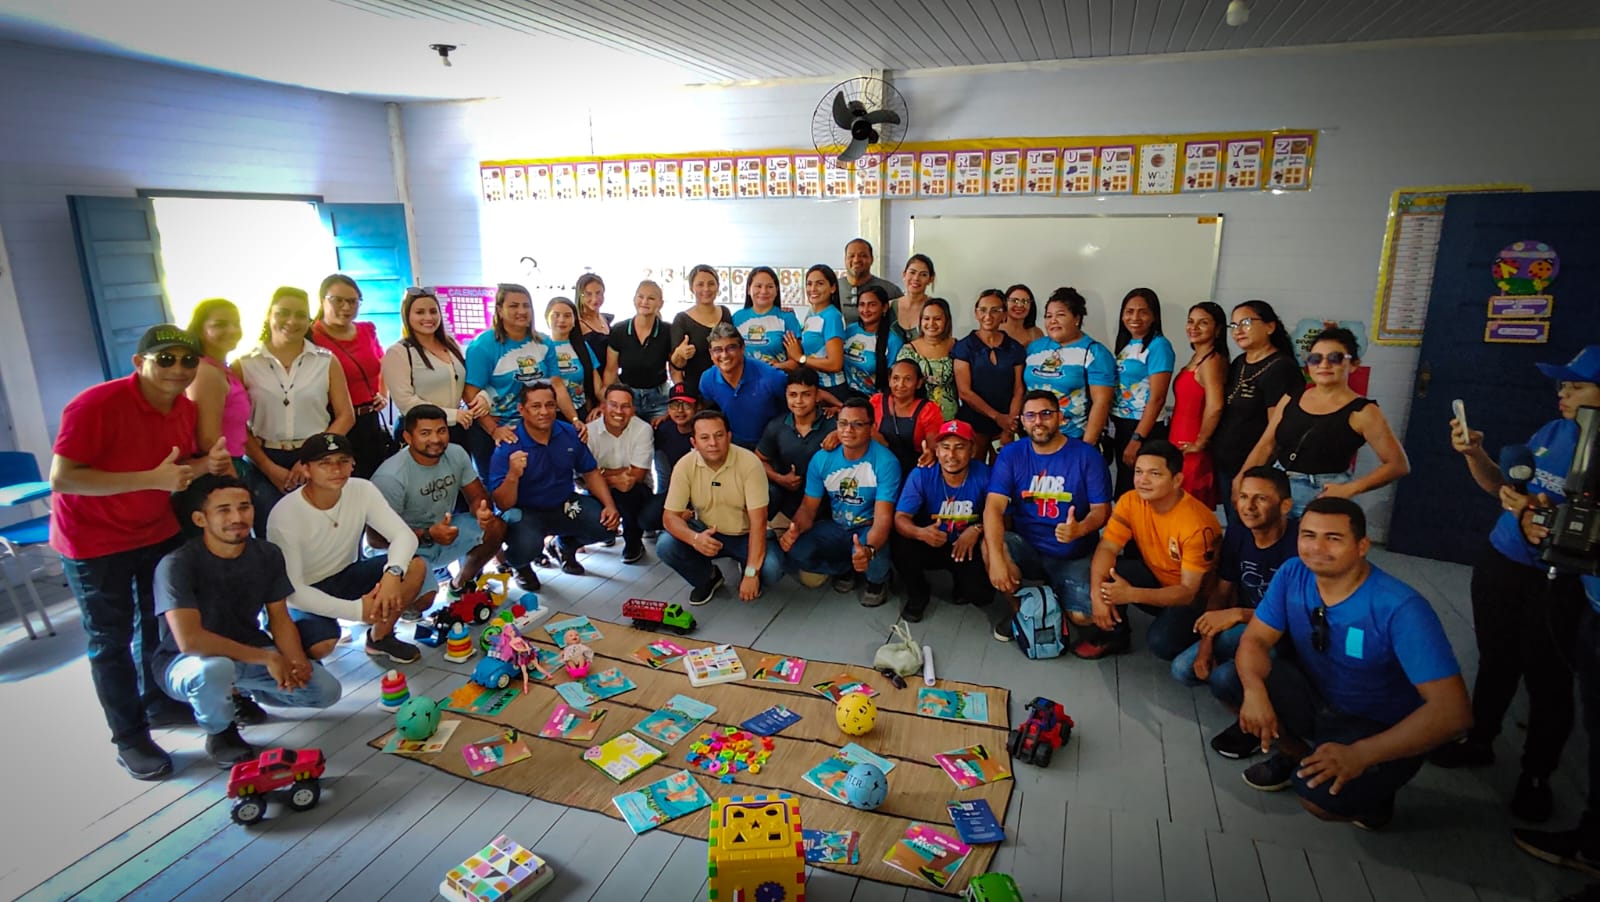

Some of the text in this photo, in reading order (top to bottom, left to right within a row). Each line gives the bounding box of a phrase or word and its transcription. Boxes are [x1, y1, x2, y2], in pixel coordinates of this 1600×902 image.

[1188, 146, 1201, 158] X
[1231, 144, 1244, 157] Y
[1275, 141, 1290, 154] Z
[889, 154, 900, 167] P
[923, 155, 934, 167] Q
[957, 155, 968, 167] R
[993, 153, 1004, 166] S
[1030, 152, 1041, 164] T
[1066, 151, 1078, 163] U
[1103, 151, 1116, 162] V
[738, 160, 749, 171] K
[767, 160, 777, 171] L
[665, 268, 674, 283] 3
[732, 269, 744, 285] 6
[780, 269, 792, 286] 8
[420, 474, 456, 496] GUCCI
[1029, 475, 1065, 492] MDB
[938, 500, 973, 516] MDB
[1034, 498, 1060, 518] 15
